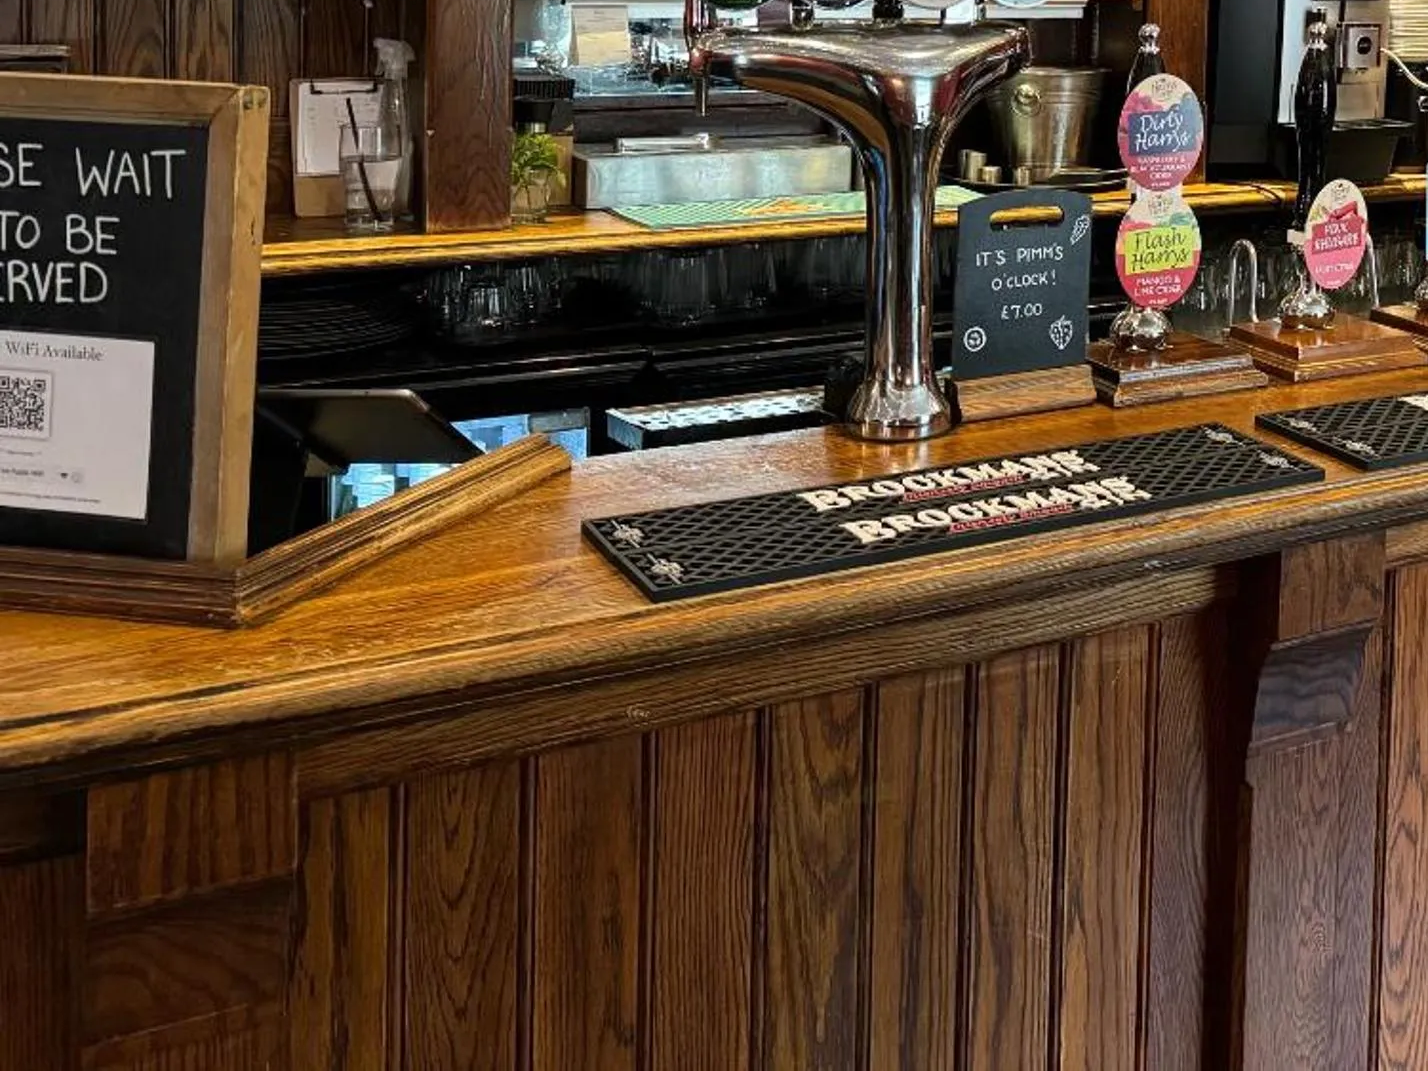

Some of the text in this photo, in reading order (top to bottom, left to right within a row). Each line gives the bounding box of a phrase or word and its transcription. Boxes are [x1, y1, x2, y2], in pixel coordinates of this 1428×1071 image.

[1140, 110, 1184, 133] Dirty
[75, 148, 186, 198] WAIT
[66, 214, 119, 255] BE
[1016, 242, 1064, 264] PIMM'S
[0, 260, 108, 304] RVED
[1000, 302, 1043, 320] £7.00
[5, 340, 105, 361] WiFi Available
[795, 449, 1102, 513] BROCKMANS
[837, 476, 1152, 545] BROCKMANS
